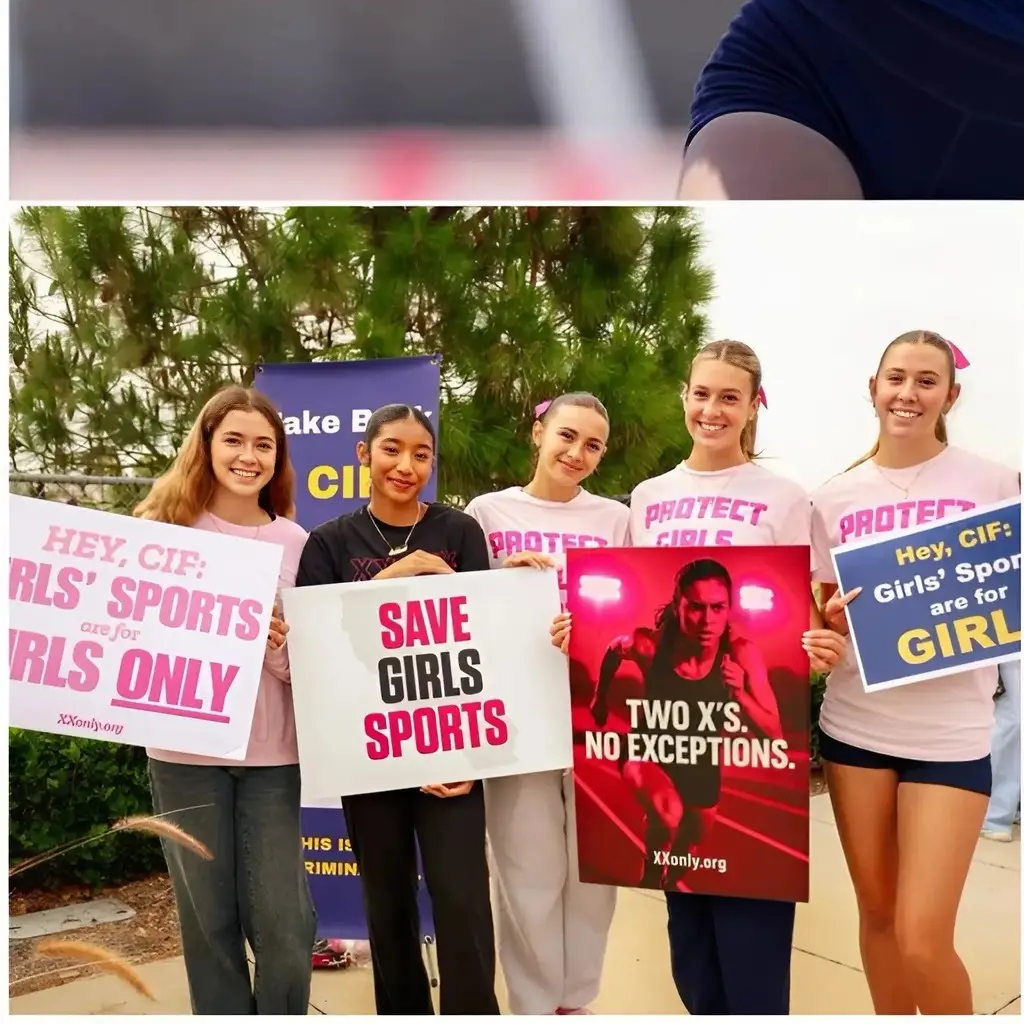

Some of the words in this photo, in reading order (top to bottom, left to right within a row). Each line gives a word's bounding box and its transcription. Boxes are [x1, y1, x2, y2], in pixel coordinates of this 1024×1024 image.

[279, 409, 341, 435] ake
[645, 496, 767, 529] PROTECT
[42, 525, 127, 568] HEY,
[138, 543, 207, 579] CIF:
[895, 541, 951, 566] Hey,
[958, 521, 1012, 548] CIF:
[9, 556, 97, 610] RLS'
[107, 576, 263, 641] SPORTS
[874, 568, 945, 604] Girls'
[930, 595, 968, 616] are
[974, 585, 1008, 605] for
[81, 621, 110, 636] are
[109, 623, 141, 642] for
[378, 595, 471, 650] SAVE
[116, 648, 240, 713] ONLY
[378, 648, 483, 704] GIRLS
[364, 699, 508, 760] SPORTS
[626, 698, 689, 730] TWO
[697, 700, 748, 733] X'S.
[585, 730, 620, 761] NO
[627, 731, 796, 770] EXCEPTIONS.
[304, 861, 360, 876] RIMIN
[653, 850, 727, 873] XXonly.org
